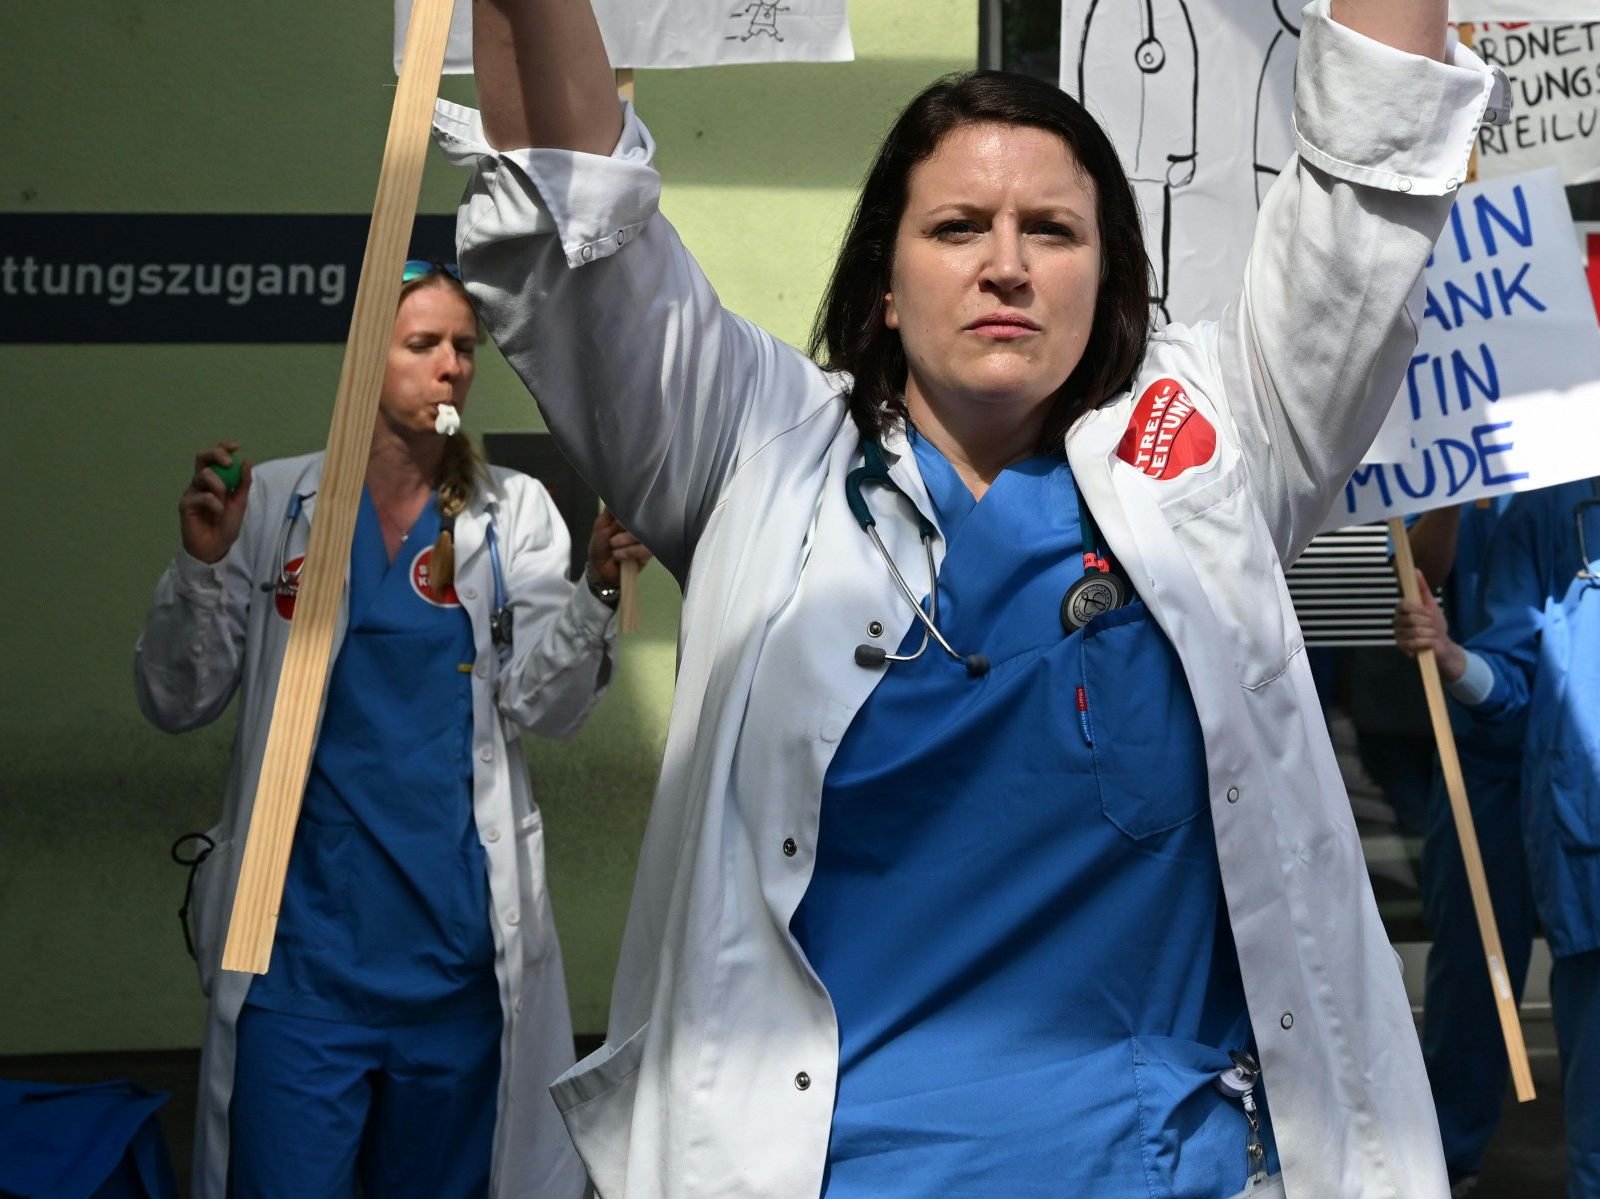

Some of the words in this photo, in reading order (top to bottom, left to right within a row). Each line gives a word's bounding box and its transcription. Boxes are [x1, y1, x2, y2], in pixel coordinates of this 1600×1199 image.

[1426, 184, 1533, 269] IN
[1, 256, 346, 306] ttungszugang
[1345, 421, 1529, 513] MÜDE
